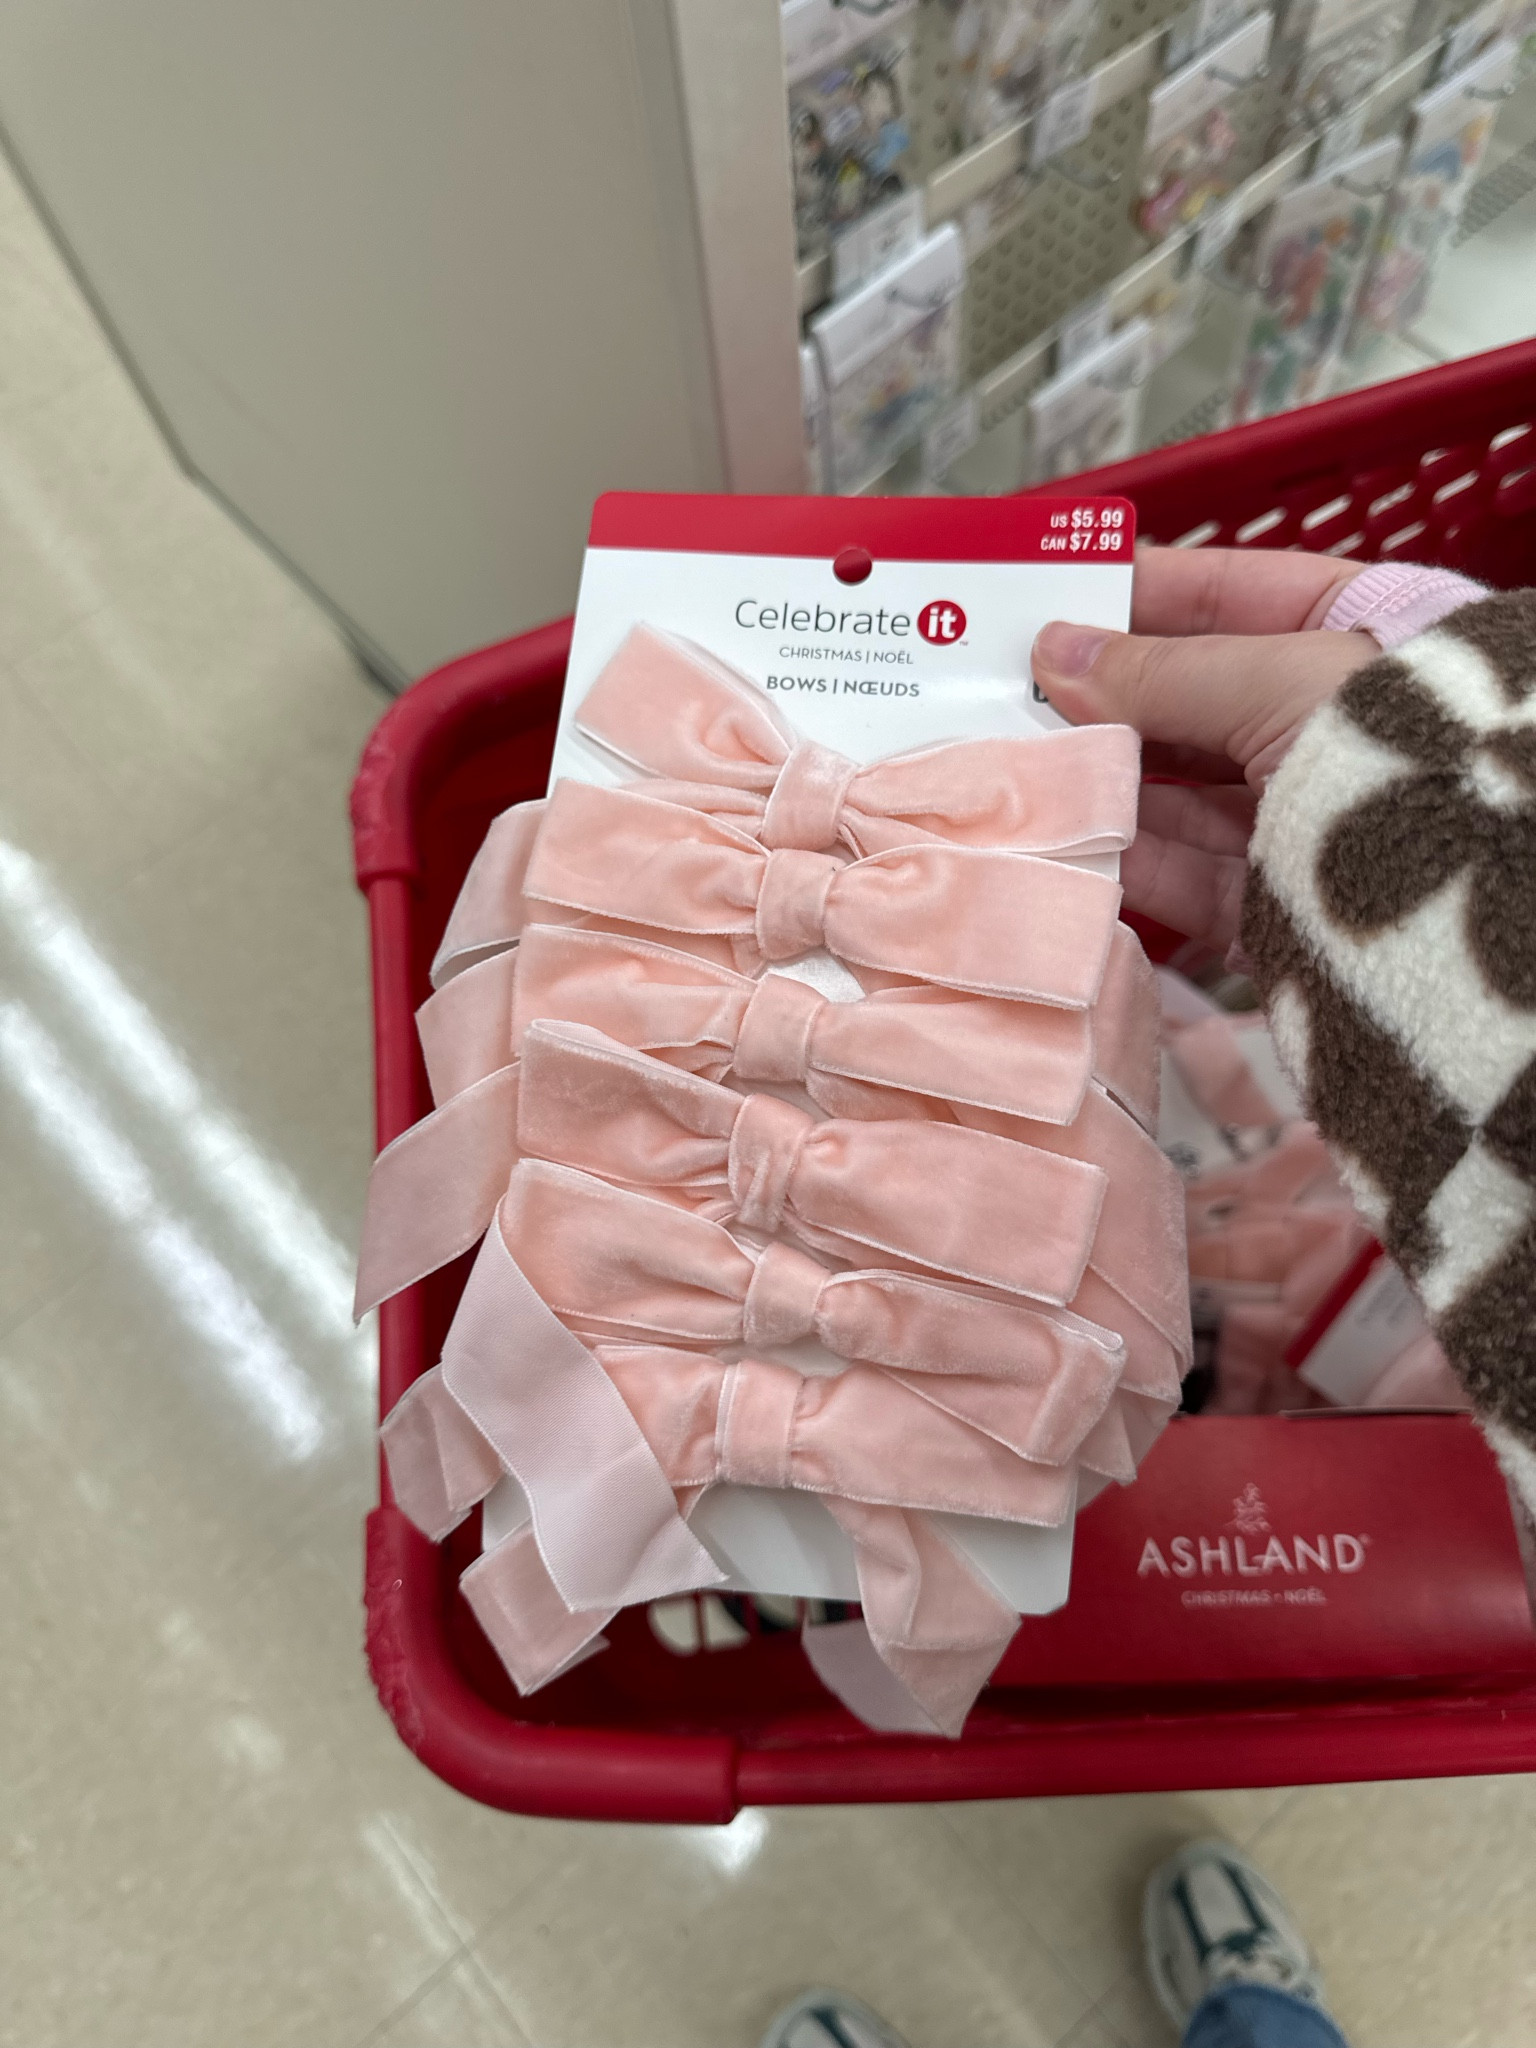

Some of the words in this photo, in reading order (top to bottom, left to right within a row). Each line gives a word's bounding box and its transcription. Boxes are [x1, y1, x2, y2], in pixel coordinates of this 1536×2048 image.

[1050, 512, 1068, 528] US
[1070, 507, 1124, 529] $5.99
[1040, 534, 1067, 551] CAN
[1069, 530, 1122, 552] $7.99
[735, 599, 911, 637] Celebrate
[927, 607, 957, 639] it
[779, 646, 862, 662] CHRISTMAS
[873, 650, 914, 665] NOËL
[766, 675, 827, 693] BOWS
[843, 680, 920, 698] NŒUDS
[1137, 1533, 1366, 1578] ASHLAND
